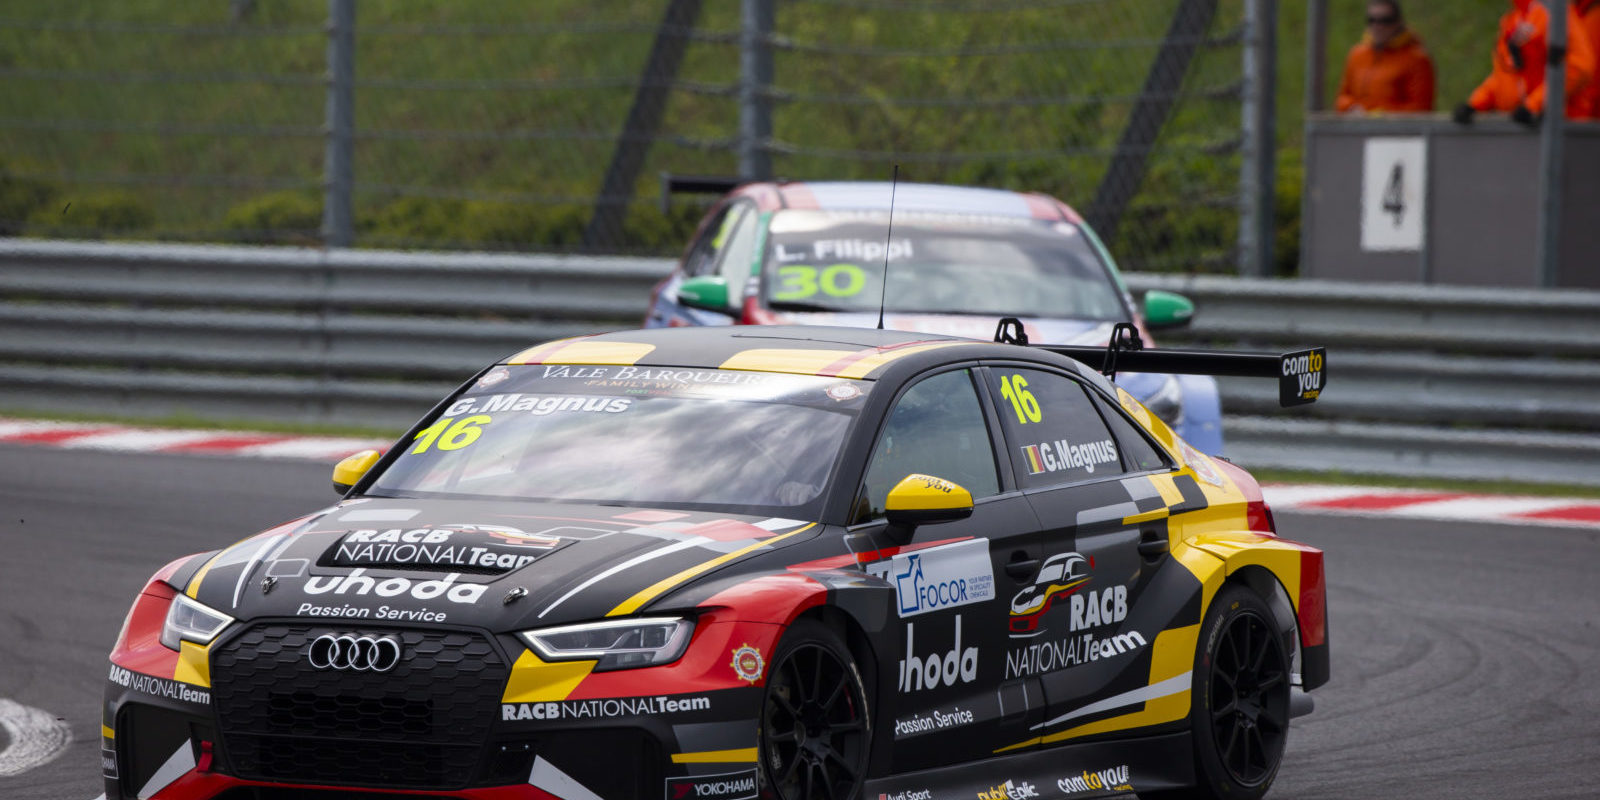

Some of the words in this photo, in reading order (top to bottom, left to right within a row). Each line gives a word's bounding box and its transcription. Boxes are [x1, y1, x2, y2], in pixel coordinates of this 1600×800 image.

[1383, 162, 1405, 229] 4
[813, 238, 913, 262] Filippi
[774, 264, 867, 300] 30
[542, 365, 608, 380] VALE
[1297, 371, 1320, 397] you
[443, 393, 632, 417] G.Magnus
[1000, 374, 1042, 424] 16
[411, 415, 492, 455] 16
[1040, 439, 1118, 473] G.Magnus
[924, 482, 952, 493] you
[345, 529, 454, 543] RACB
[303, 568, 490, 604] uhoda
[920, 579, 968, 610] FOCOR
[296, 603, 370, 619] Passion
[376, 606, 447, 622] Service
[1070, 585, 1128, 632] RACB
[934, 707, 974, 727] Service
[694, 776, 755, 797] YOKOHAMA
[906, 789, 931, 800] Sport
